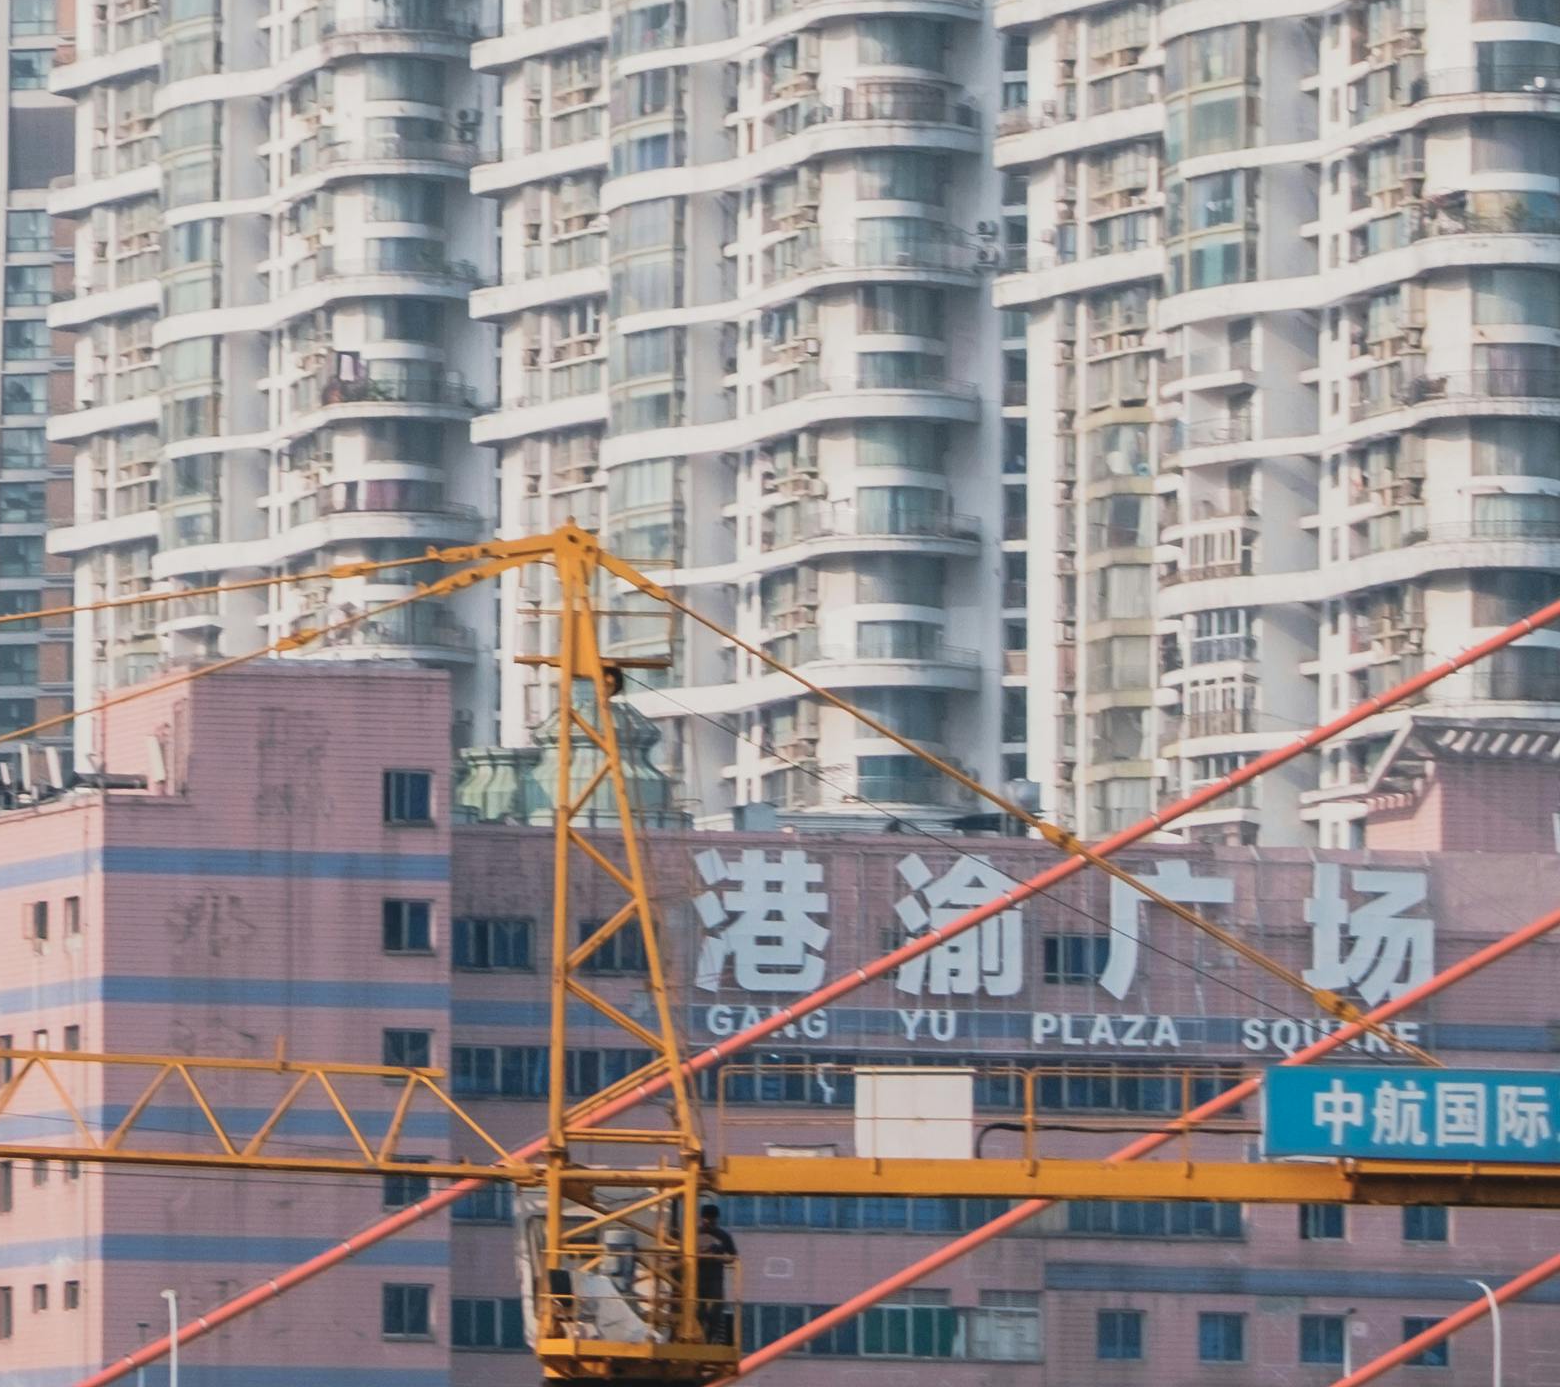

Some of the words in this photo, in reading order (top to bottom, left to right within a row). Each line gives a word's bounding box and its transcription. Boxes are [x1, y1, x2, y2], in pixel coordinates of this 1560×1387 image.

[692, 849, 1436, 1007] 港渝广场
[898, 1008, 958, 1042] YU
[1033, 1015, 1181, 1048] PLAZA
[1313, 1078, 1560, 1148] 中航国际
